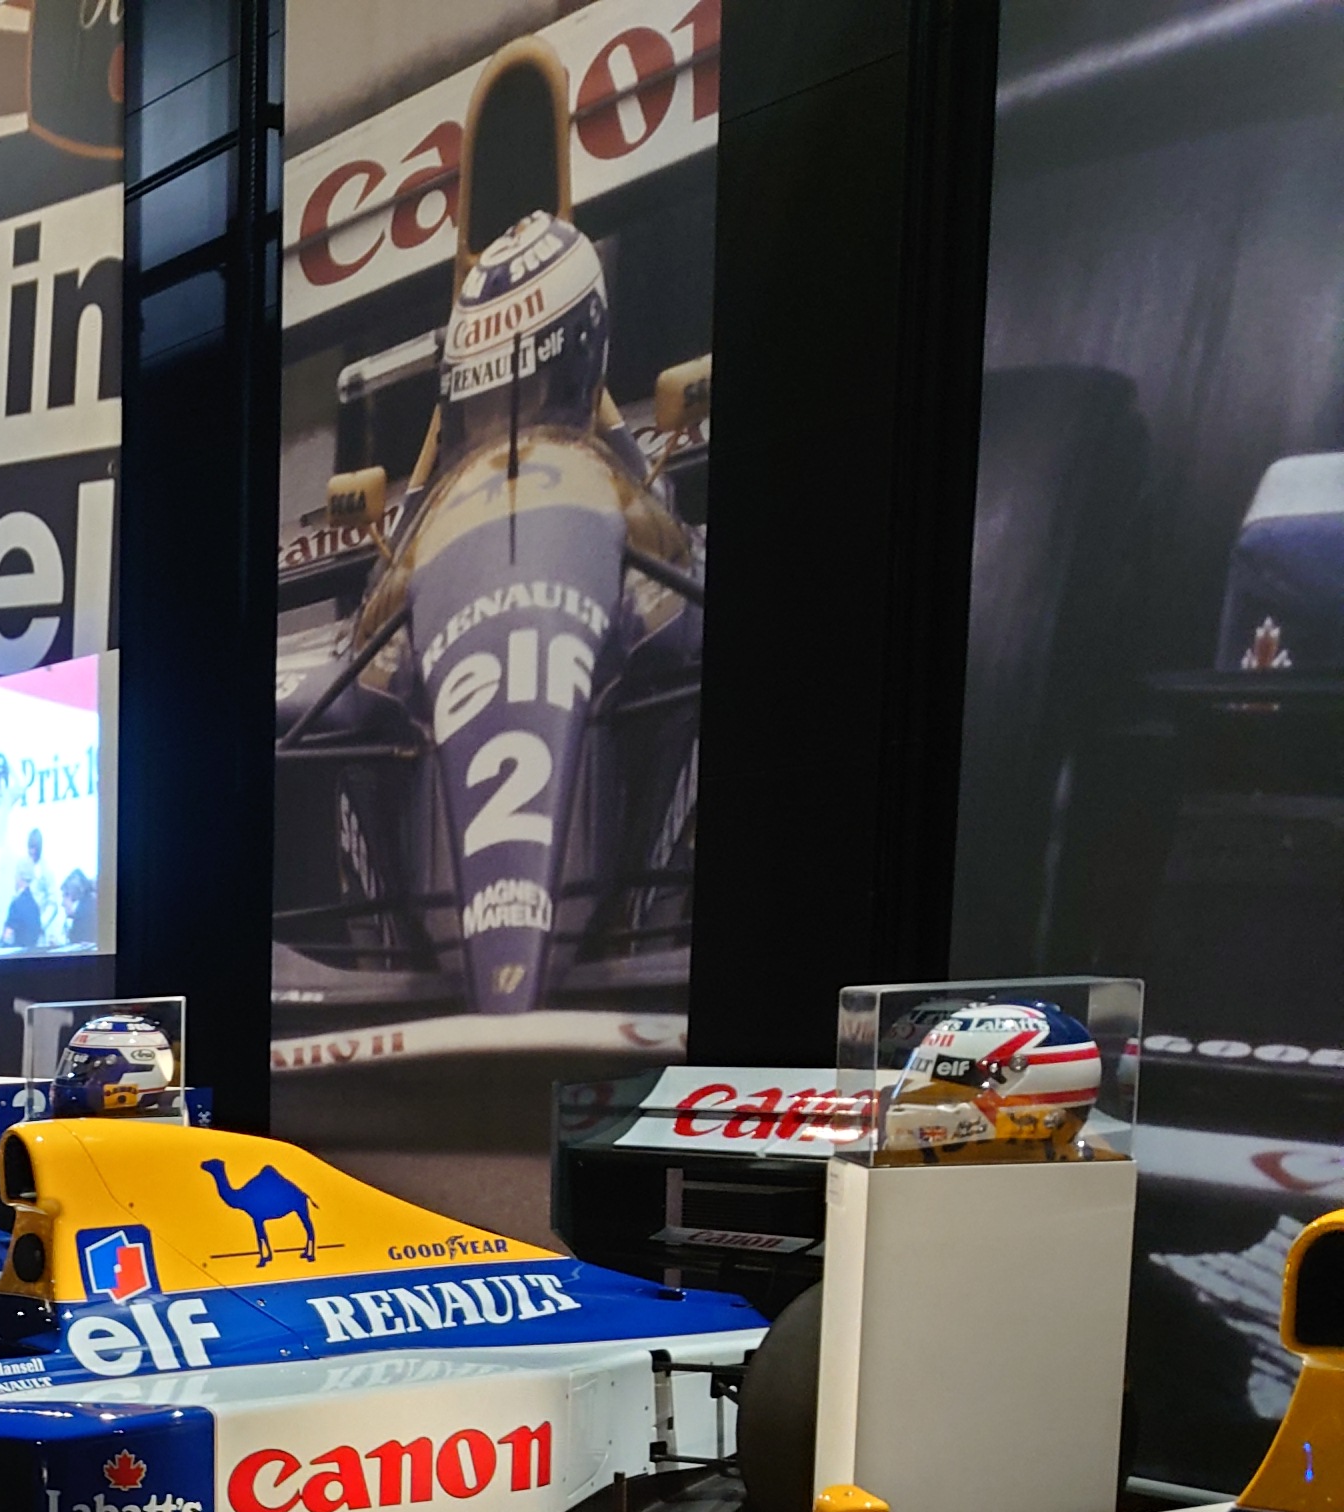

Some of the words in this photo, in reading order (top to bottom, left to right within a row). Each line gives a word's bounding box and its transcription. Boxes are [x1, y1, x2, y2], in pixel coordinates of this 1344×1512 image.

[452, 286, 546, 352] Canon
[537, 326, 565, 362] elf
[422, 582, 610, 677] RENAULT
[433, 629, 595, 745] elf
[464, 731, 553, 857] 2
[936, 1060, 970, 1077] elf
[389, 1234, 510, 1262] GOODYEAR
[67, 1299, 221, 1377] elf
[308, 1273, 581, 1344] RENAULT
